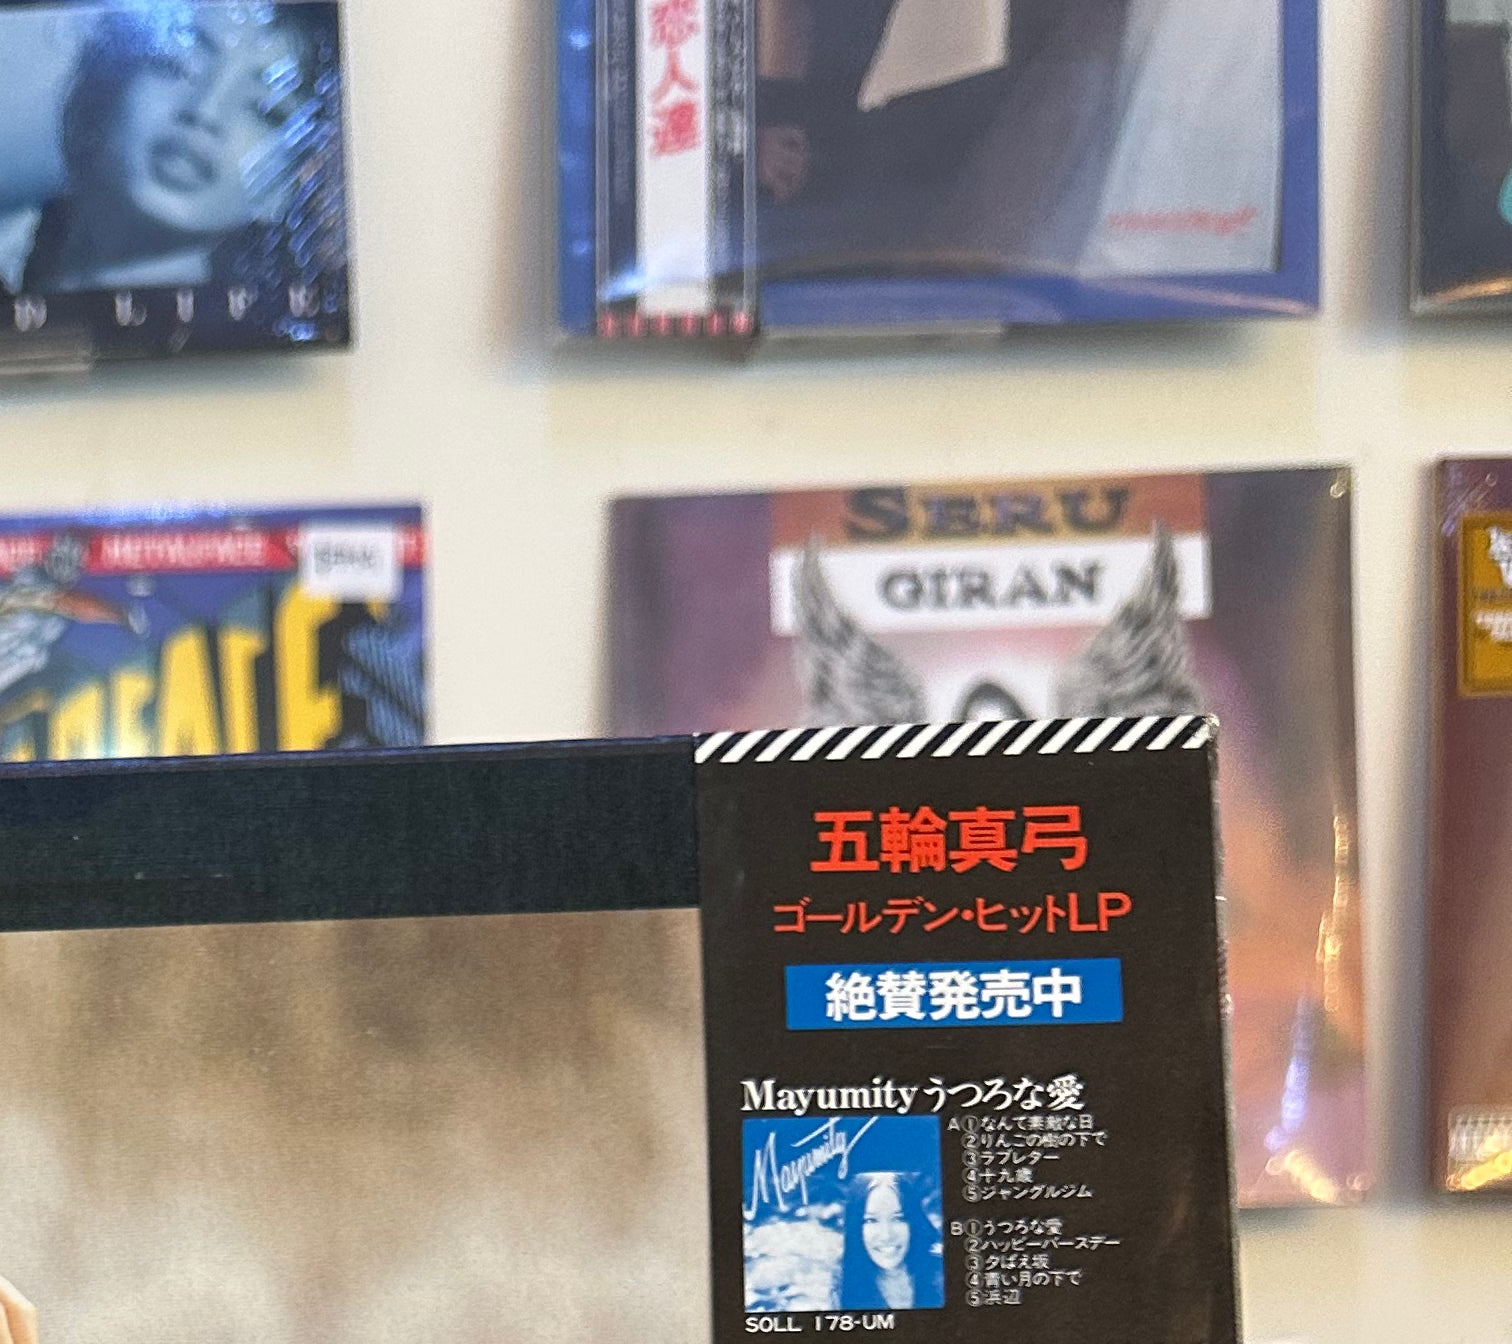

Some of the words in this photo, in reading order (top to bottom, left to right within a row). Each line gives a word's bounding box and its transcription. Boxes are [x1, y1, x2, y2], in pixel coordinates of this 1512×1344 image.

[843, 483, 1131, 540] SERU
[876, 558, 1103, 613] GIRAN
[810, 805, 1088, 873] 五輪真弓
[826, 967, 1083, 1021] 絶賛発売中
[744, 1310, 802, 1333] SOLL
[810, 1309, 895, 1331] 178-UM
